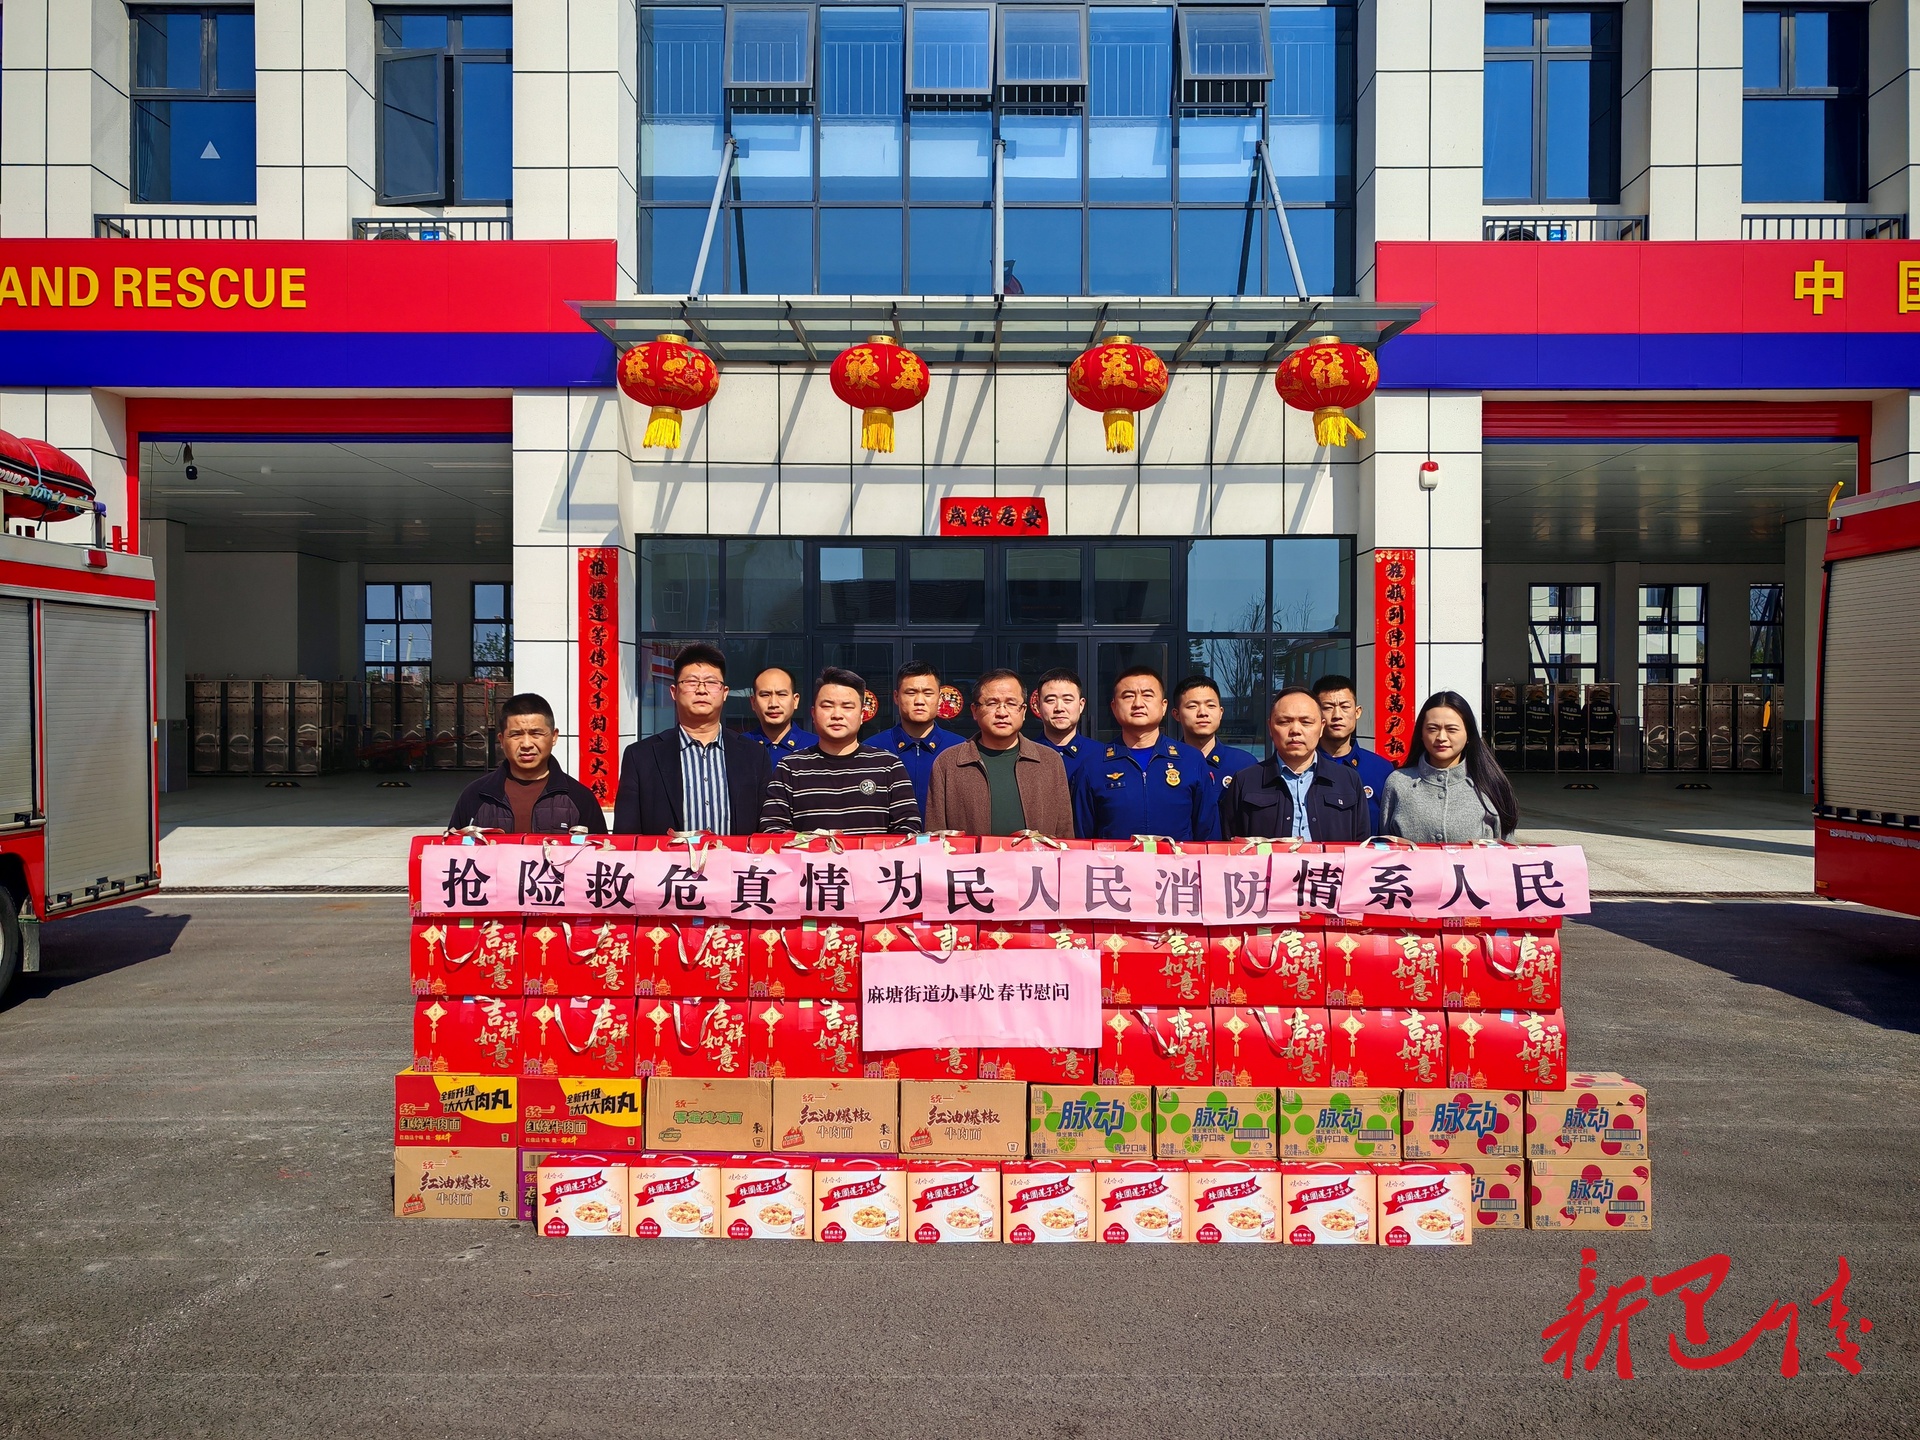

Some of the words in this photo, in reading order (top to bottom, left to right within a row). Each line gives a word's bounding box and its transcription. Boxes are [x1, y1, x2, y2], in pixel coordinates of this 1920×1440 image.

[0, 267, 98, 307] AND
[114, 267, 306, 308] RESCUE
[441, 1085, 475, 1101] 全新升级
[567, 1088, 601, 1104] 全新升级
[800, 1105, 872, 1125] 红油爆椒
[927, 1105, 1000, 1126] 红油爆椒
[1057, 1099, 1124, 1136] 脉动
[1192, 1106, 1238, 1131] 脉动
[1316, 1107, 1362, 1133] 脉动
[1430, 1101, 1497, 1138] 脉动
[1564, 1107, 1609, 1132] 脉动
[400, 1117, 461, 1132] 红烧牛肉面
[525, 1120, 587, 1134] 红烧牛肉面
[816, 1125, 854, 1138] 牛肉面
[945, 1127, 982, 1141] 牛肉面
[1192, 1134, 1226, 1142] 青柠口味
[1315, 1135, 1349, 1143] 青柠口味
[1562, 1135, 1596, 1143] 桃子口味
[1114, 1144, 1147, 1152] 青柠口味
[1486, 1145, 1519, 1153] 桃子口味
[419, 1172, 492, 1192] 红油爆椒
[436, 1192, 473, 1206] 牛肉面
[1567, 1178, 1613, 1204] 脉动
[1566, 1206, 1601, 1215] 桃子口味
